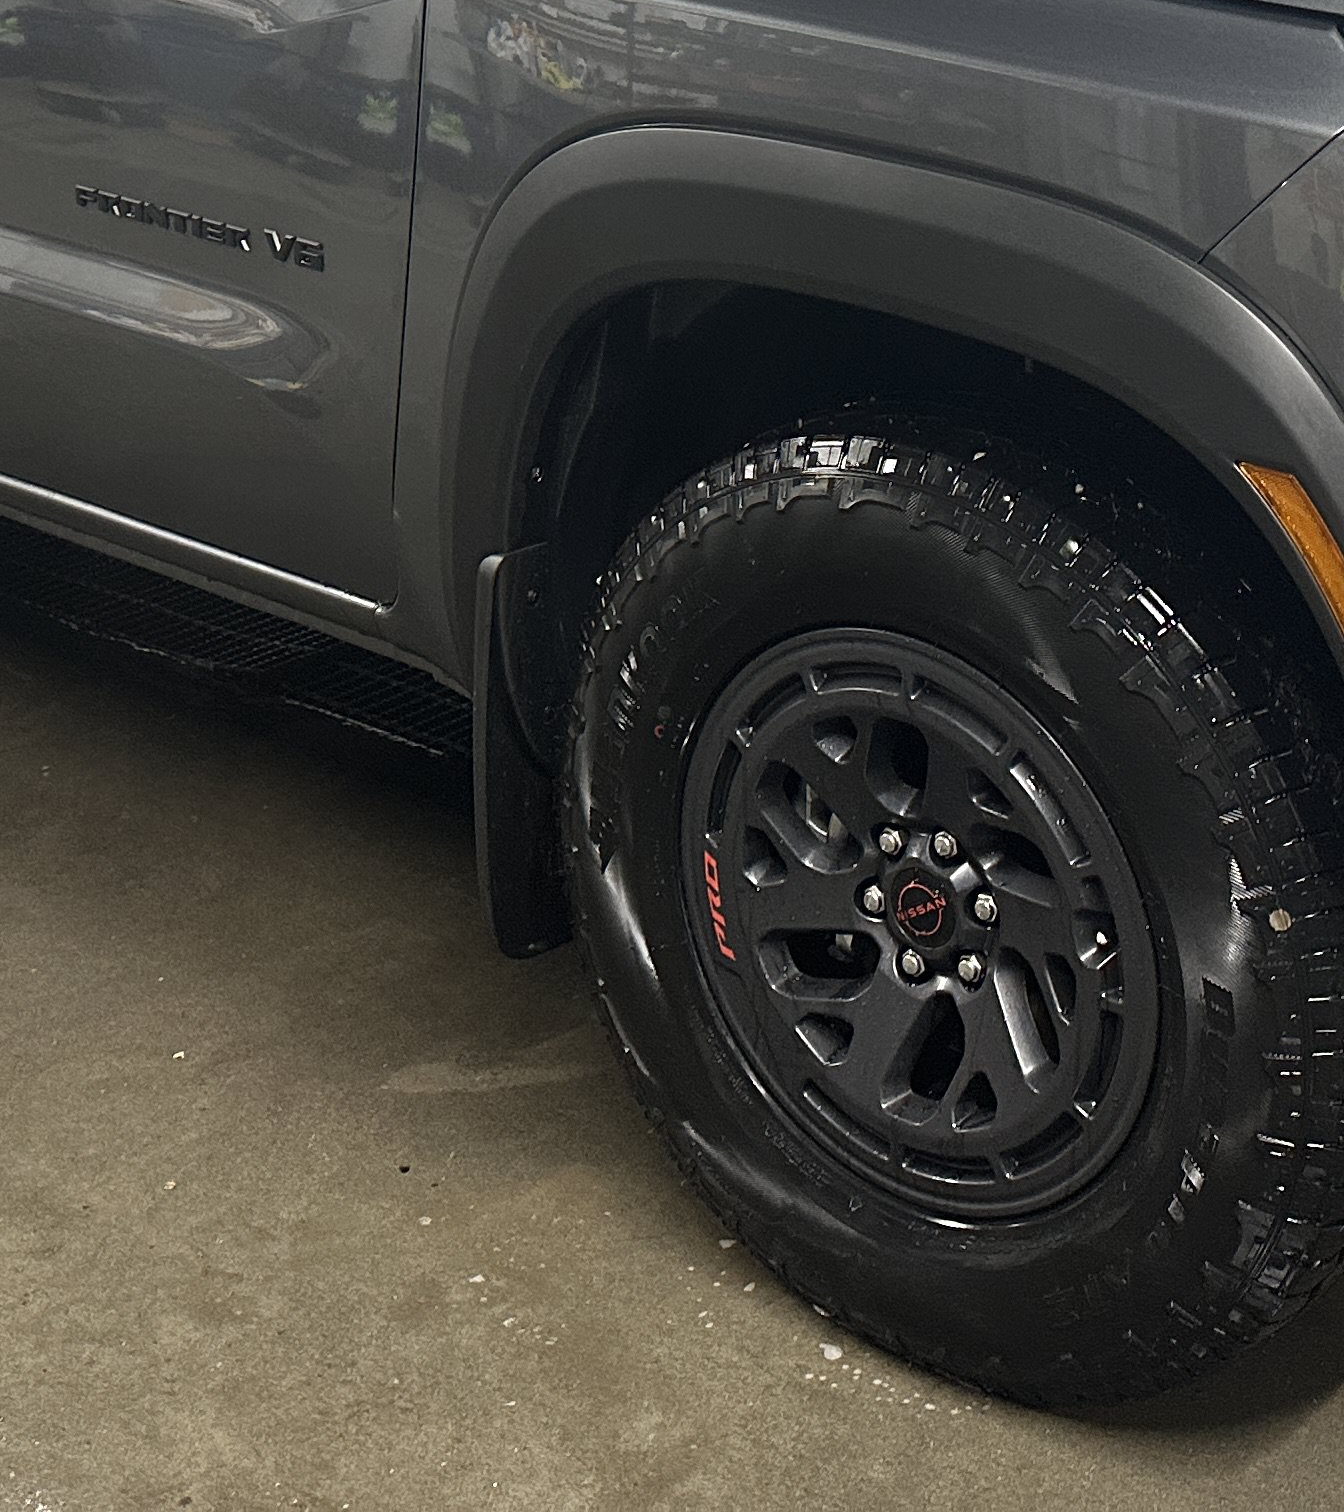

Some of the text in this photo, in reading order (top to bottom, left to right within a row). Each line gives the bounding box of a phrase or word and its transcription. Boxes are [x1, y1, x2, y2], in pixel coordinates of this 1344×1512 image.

[74, 184, 325, 273] FRONTIER V6
[703, 850, 736, 961] PRO
[897, 897, 946, 921] NISSAN
